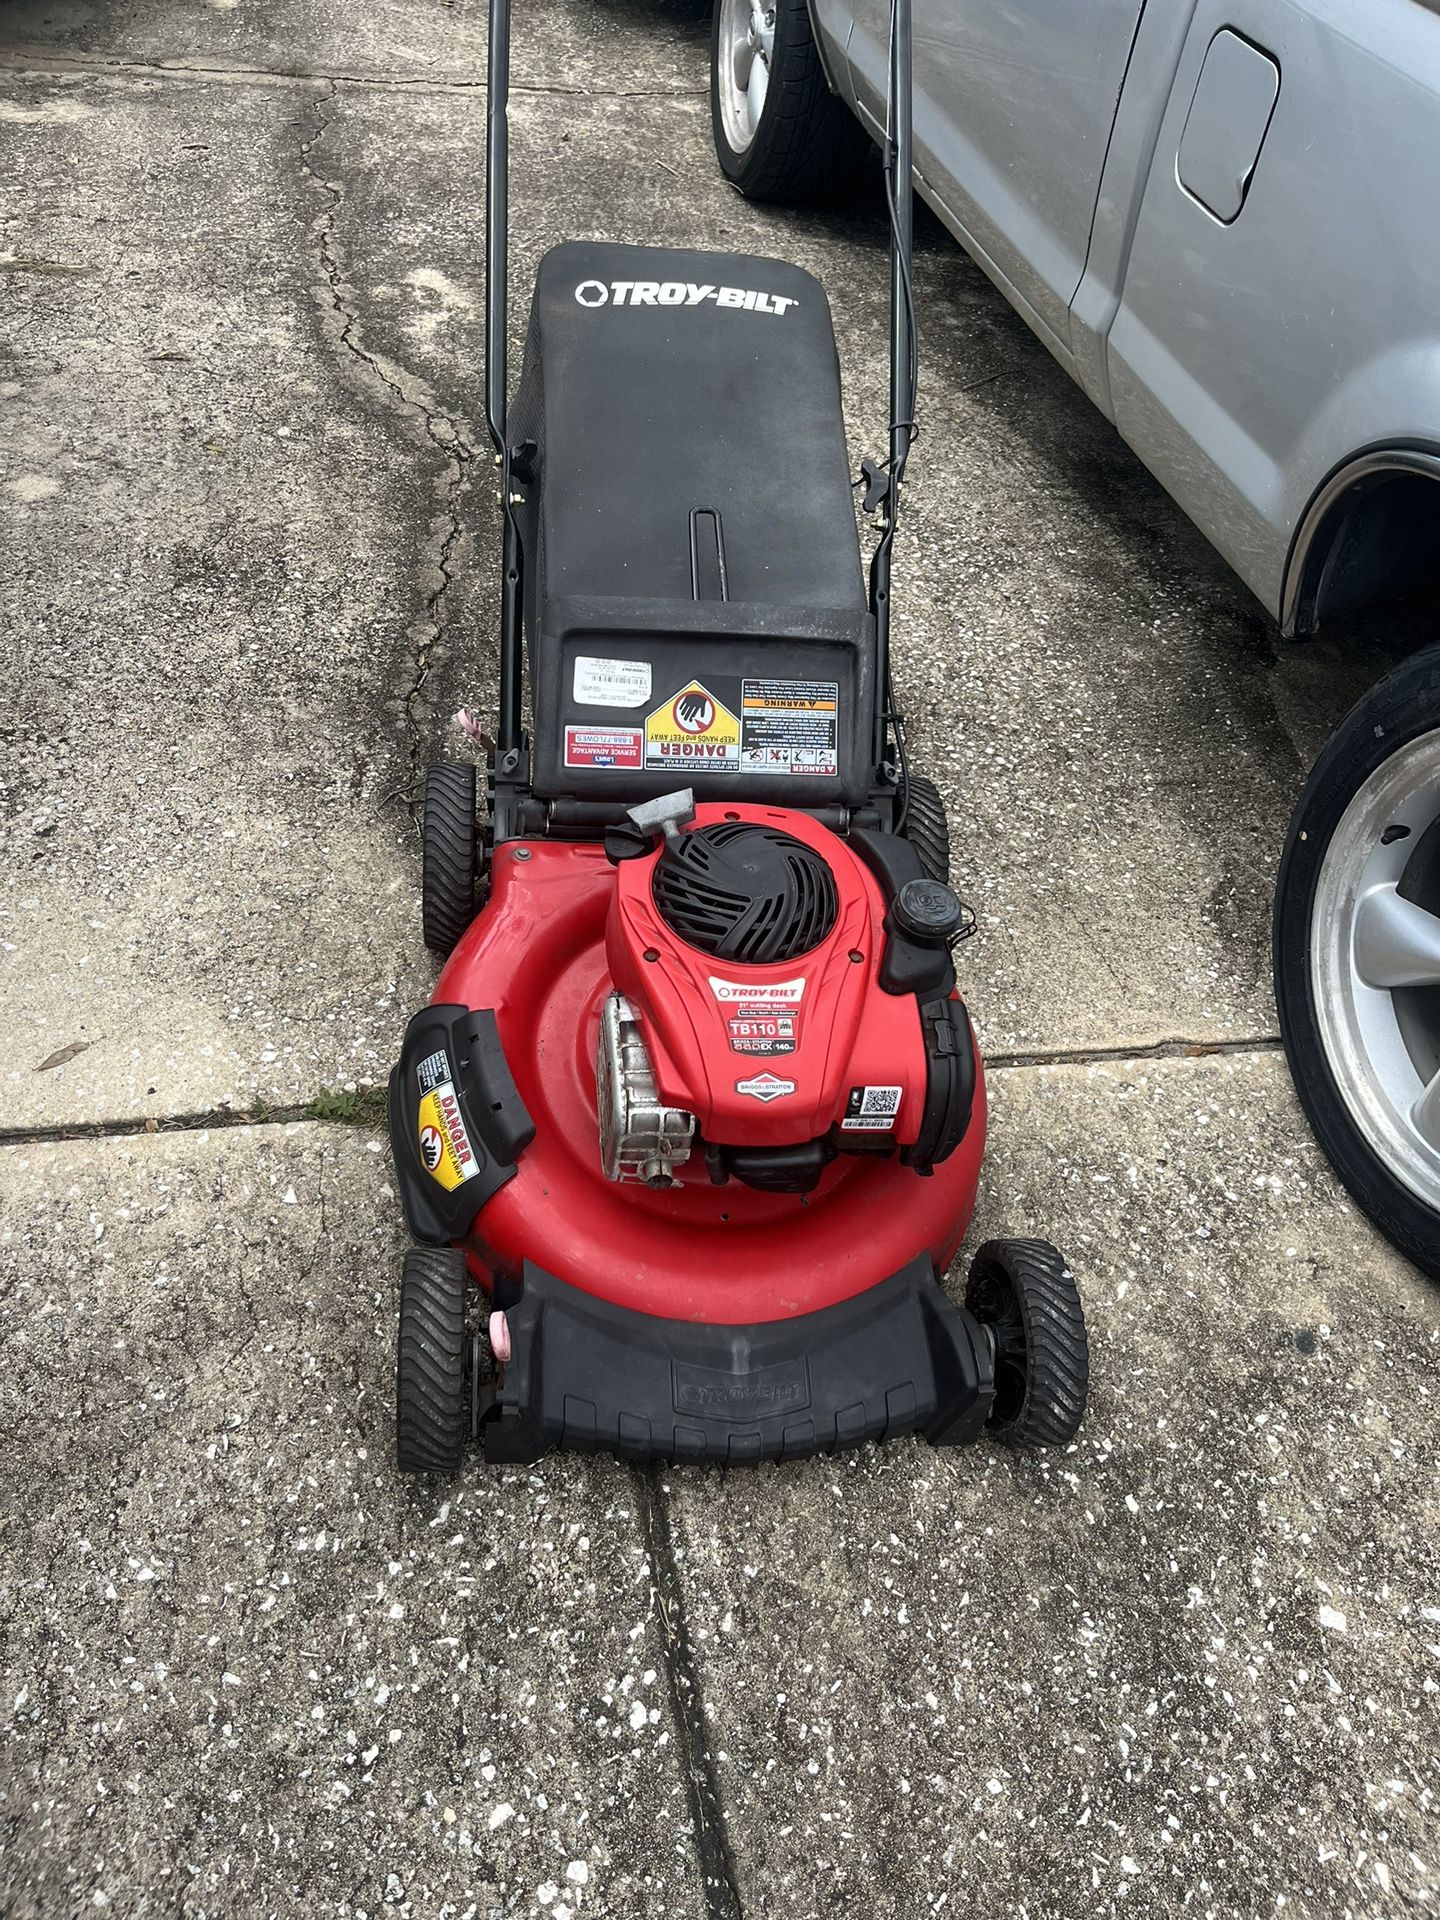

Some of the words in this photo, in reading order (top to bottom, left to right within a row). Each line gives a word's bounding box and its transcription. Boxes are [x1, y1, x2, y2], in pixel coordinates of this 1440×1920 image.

[610, 281, 797, 316] TROY-BILT
[764, 699, 806, 707] WARNING
[572, 747, 609, 756] ADVANTAGE
[610, 748, 637, 756] SERVICE
[660, 743, 727, 757] DANGER
[792, 765, 826, 773] DANGER
[731, 988, 798, 997] TROY-BILT
[730, 1023, 776, 1036] TB110
[432, 1093, 440, 1110] KEEP
[436, 1110, 447, 1132] HANDS
[441, 1094, 472, 1165] DANGER
[442, 1132, 451, 1144] and
[446, 1143, 457, 1159] FEET
[452, 1159, 464, 1179] AWAY
